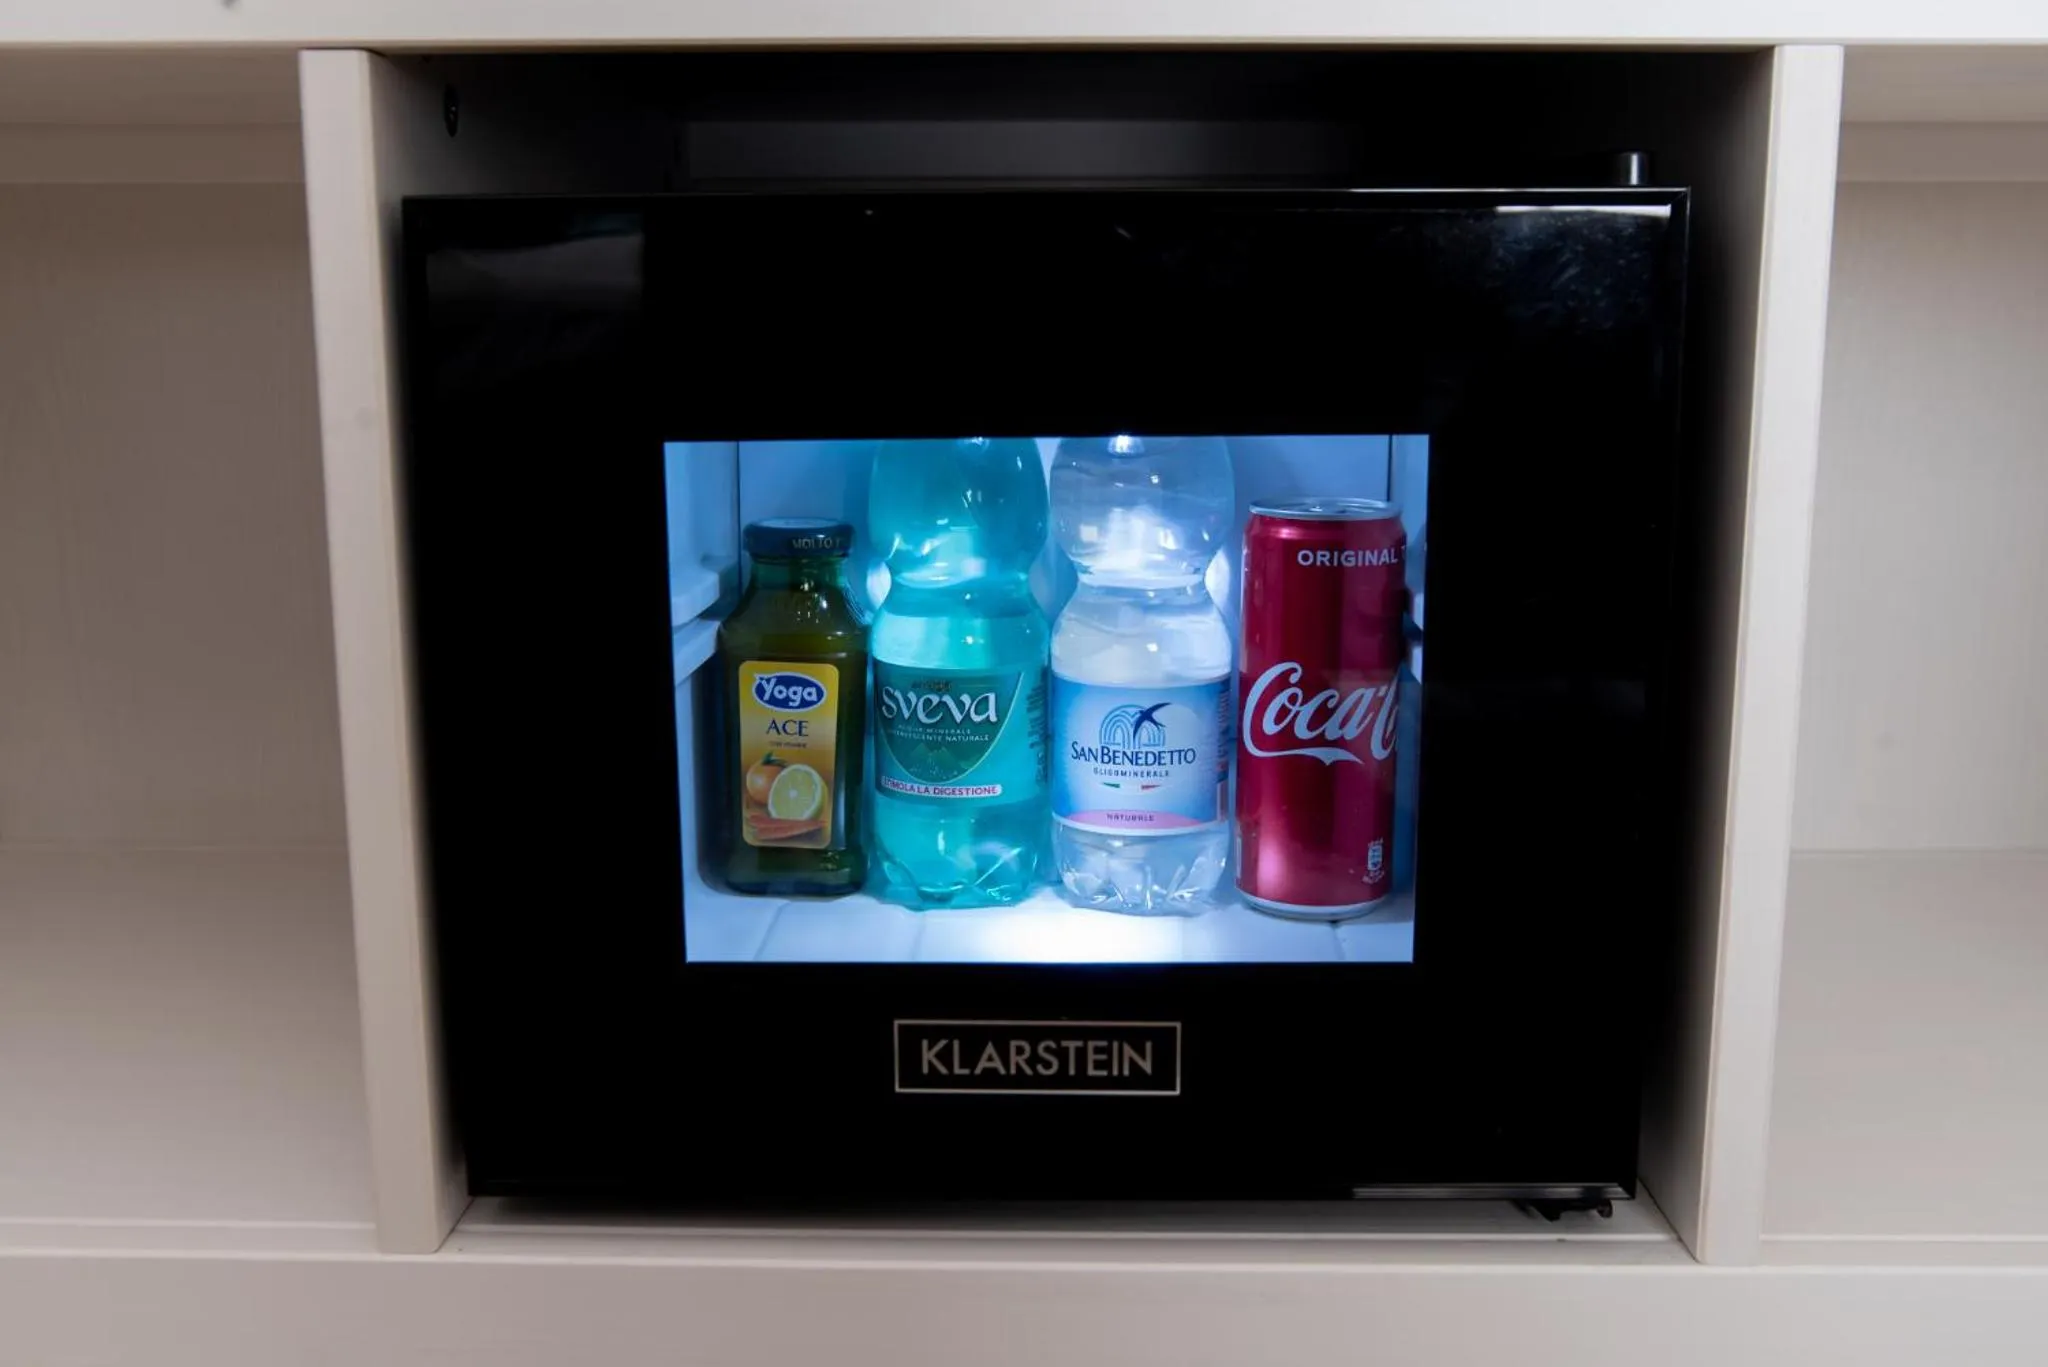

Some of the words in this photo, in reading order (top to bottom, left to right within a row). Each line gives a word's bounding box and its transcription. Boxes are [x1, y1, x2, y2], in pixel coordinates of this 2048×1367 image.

[1297, 547, 1398, 567] ORIGINAL
[761, 677, 818, 707] Yoga
[765, 717, 810, 737] ACE
[946, 734, 990, 742] NATURALE
[917, 785, 930, 795] LA
[933, 785, 998, 796] DIGESTIONE
[921, 1038, 1154, 1077] KLARSTEIN
